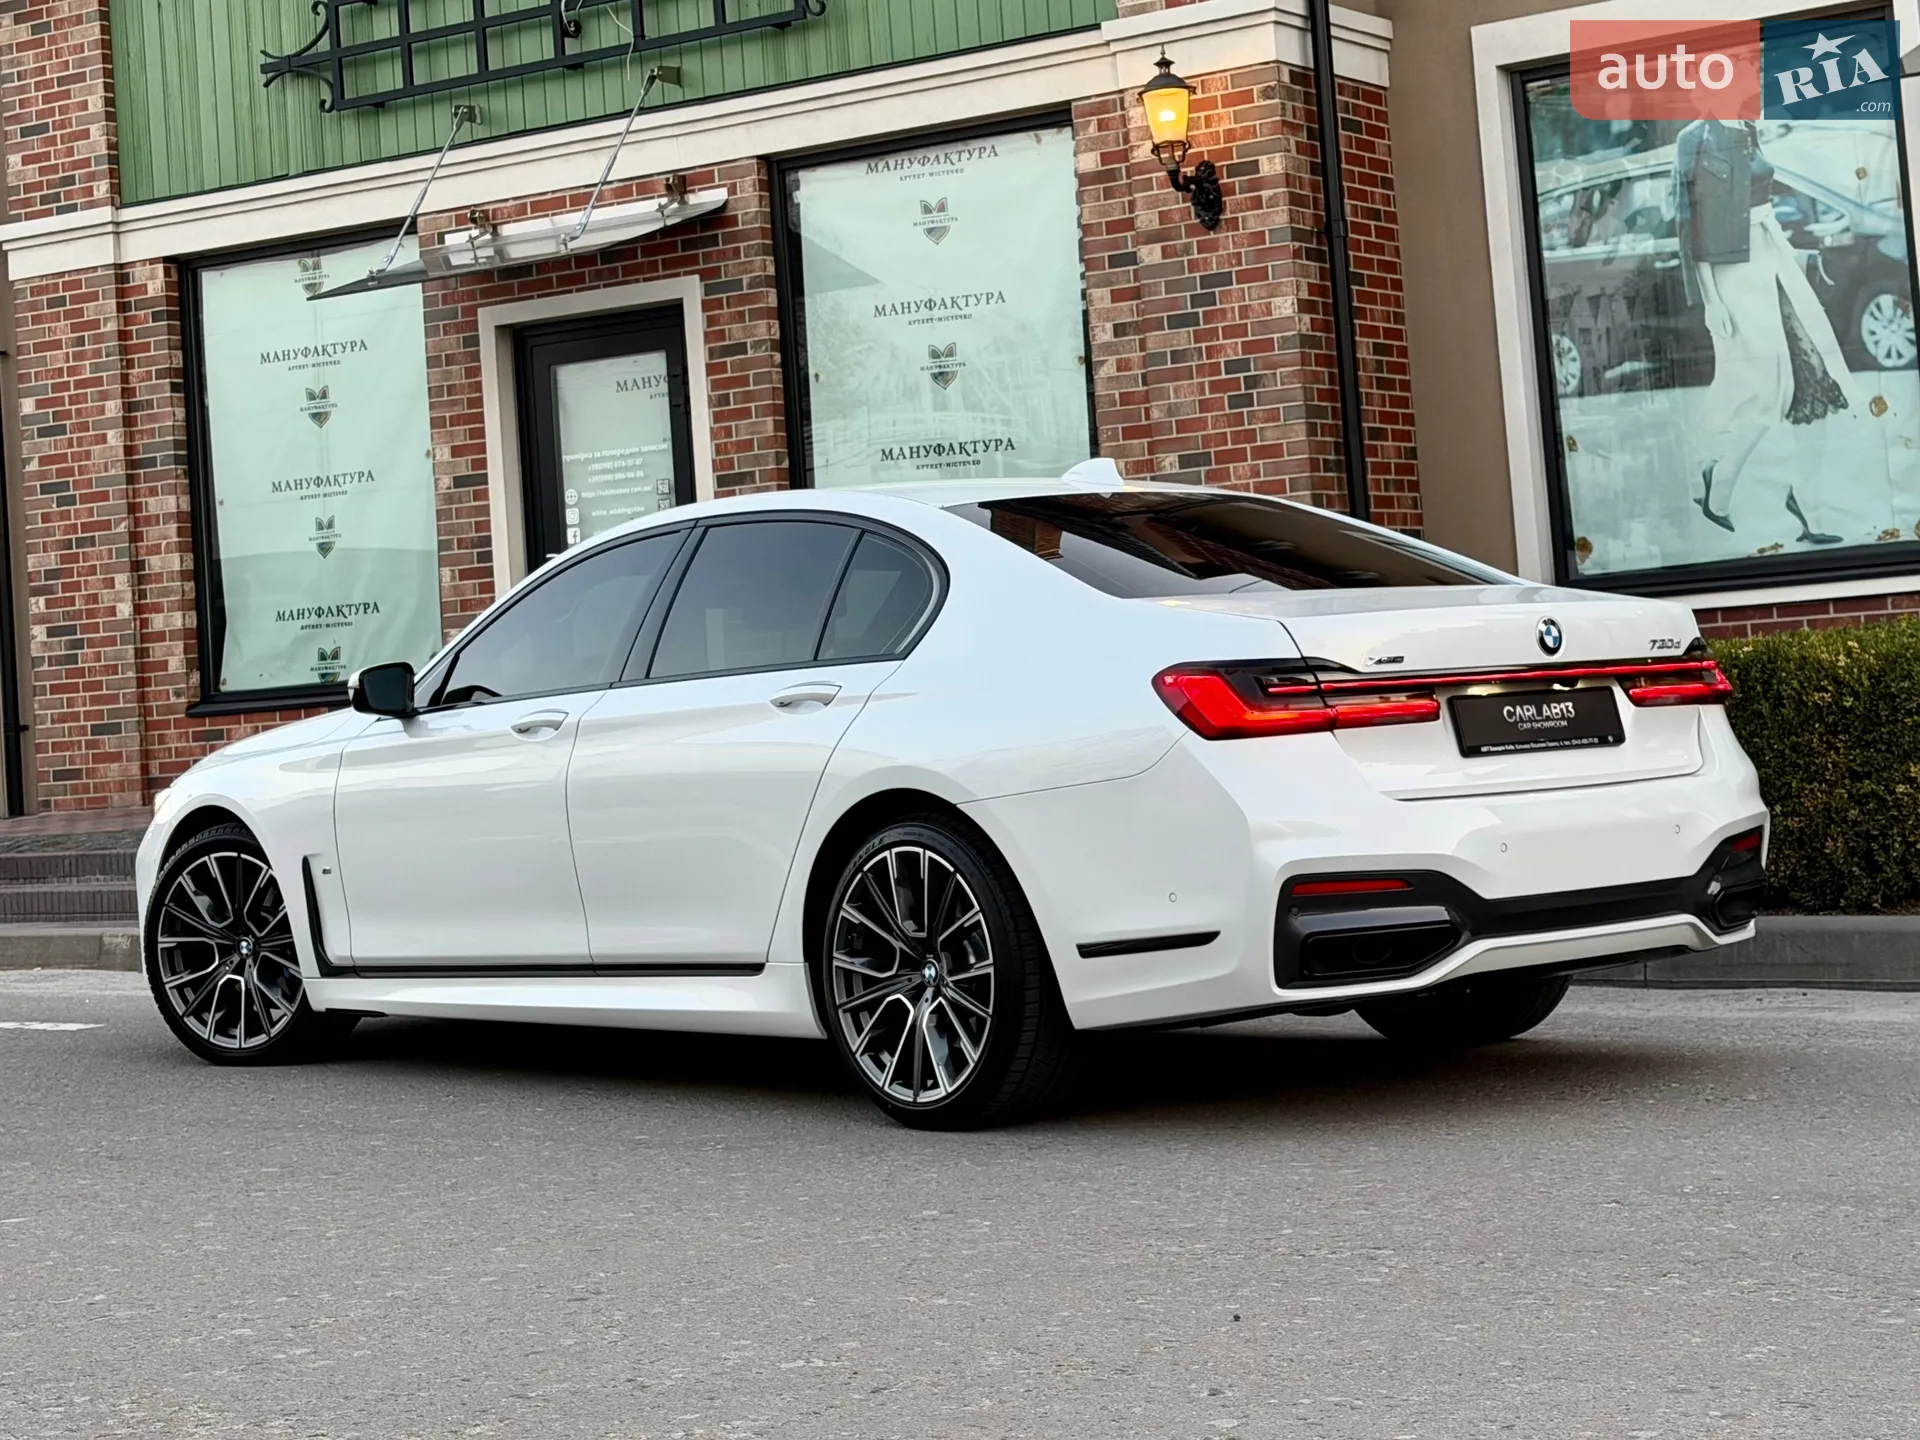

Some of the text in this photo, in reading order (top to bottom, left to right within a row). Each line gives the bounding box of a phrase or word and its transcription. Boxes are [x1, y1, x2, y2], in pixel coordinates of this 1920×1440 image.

[865, 144, 999, 175] МАНУФАКТУРА
[873, 290, 1006, 318] МАНУФАКТУРА
[260, 339, 368, 365] МАНУФАКТУРА
[880, 437, 1016, 462] МАНУФАКТУРА
[271, 469, 375, 493] МАНУФАКТУРА
[275, 601, 381, 623] МАНУФАКТУРА
[1503, 702, 1575, 723] CARLAB13
[1532, 719, 1568, 729] SHOWROOM
